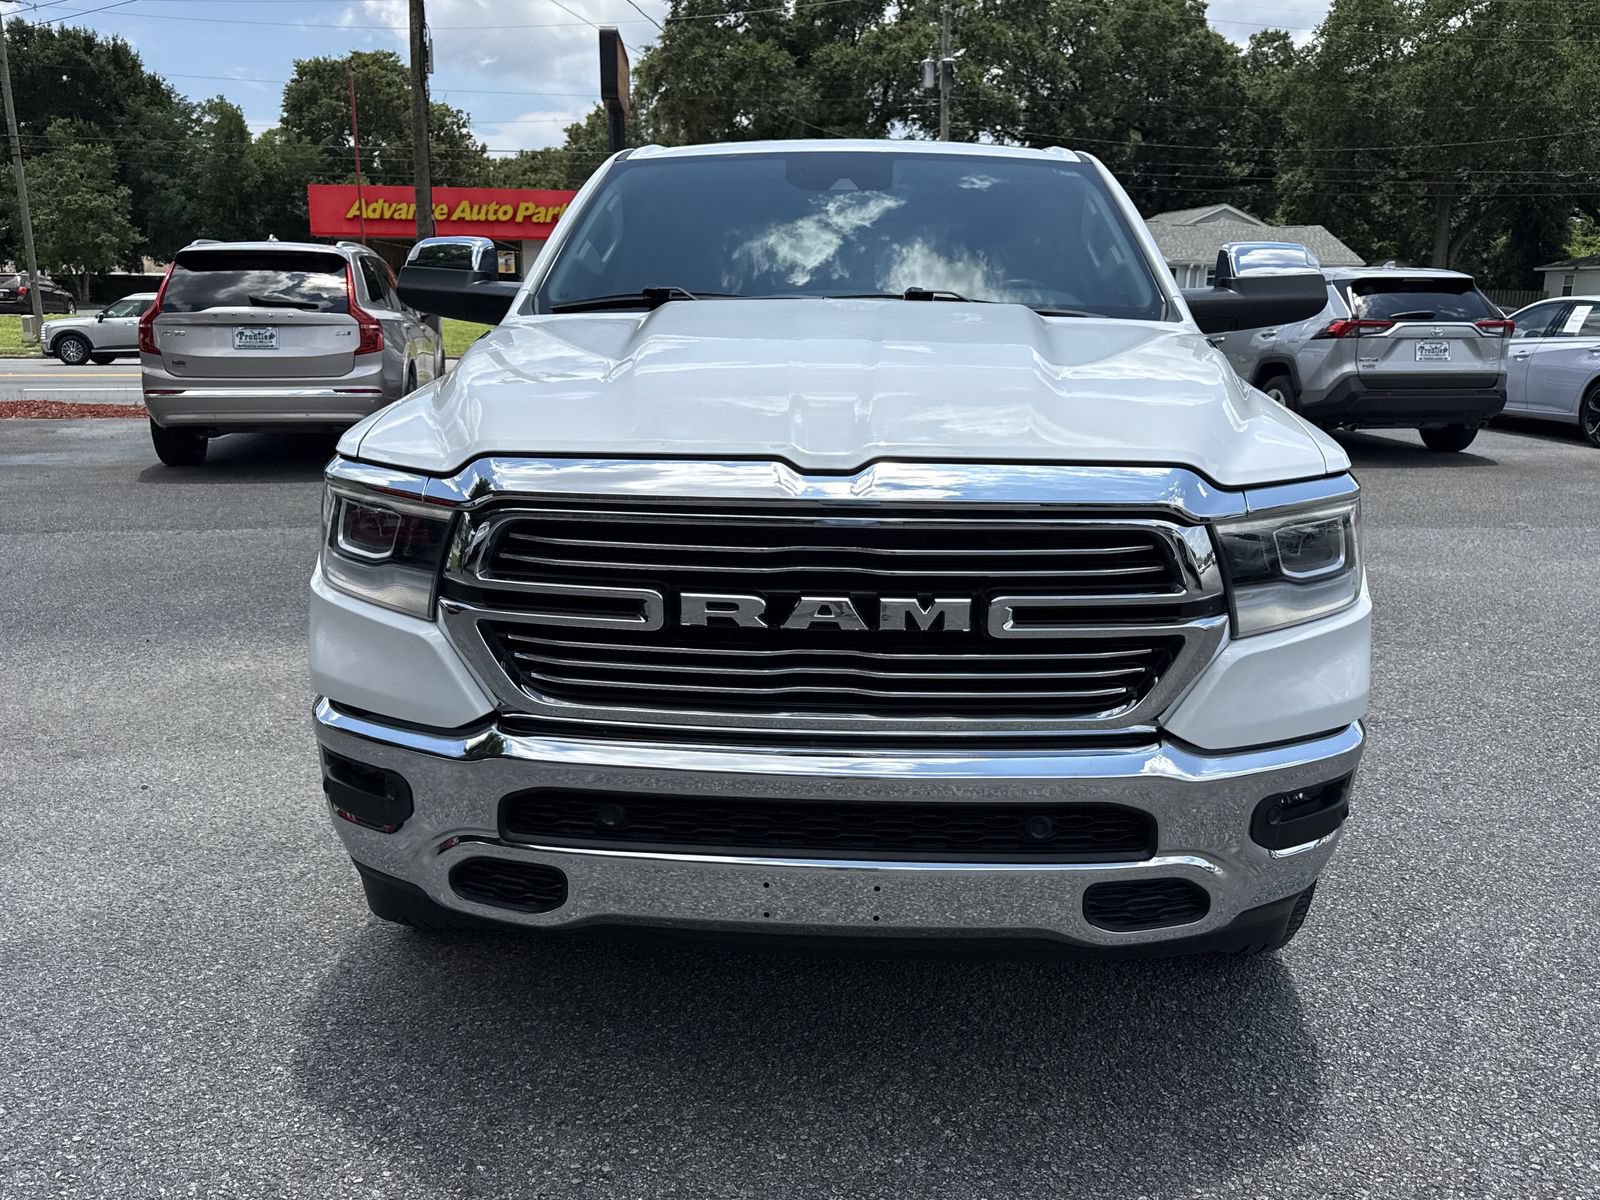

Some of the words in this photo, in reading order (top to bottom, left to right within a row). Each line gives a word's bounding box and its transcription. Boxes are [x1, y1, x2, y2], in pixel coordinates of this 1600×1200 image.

[345, 198, 448, 220] Advane
[451, 199, 514, 221] Auto
[680, 592, 972, 631] RAM
